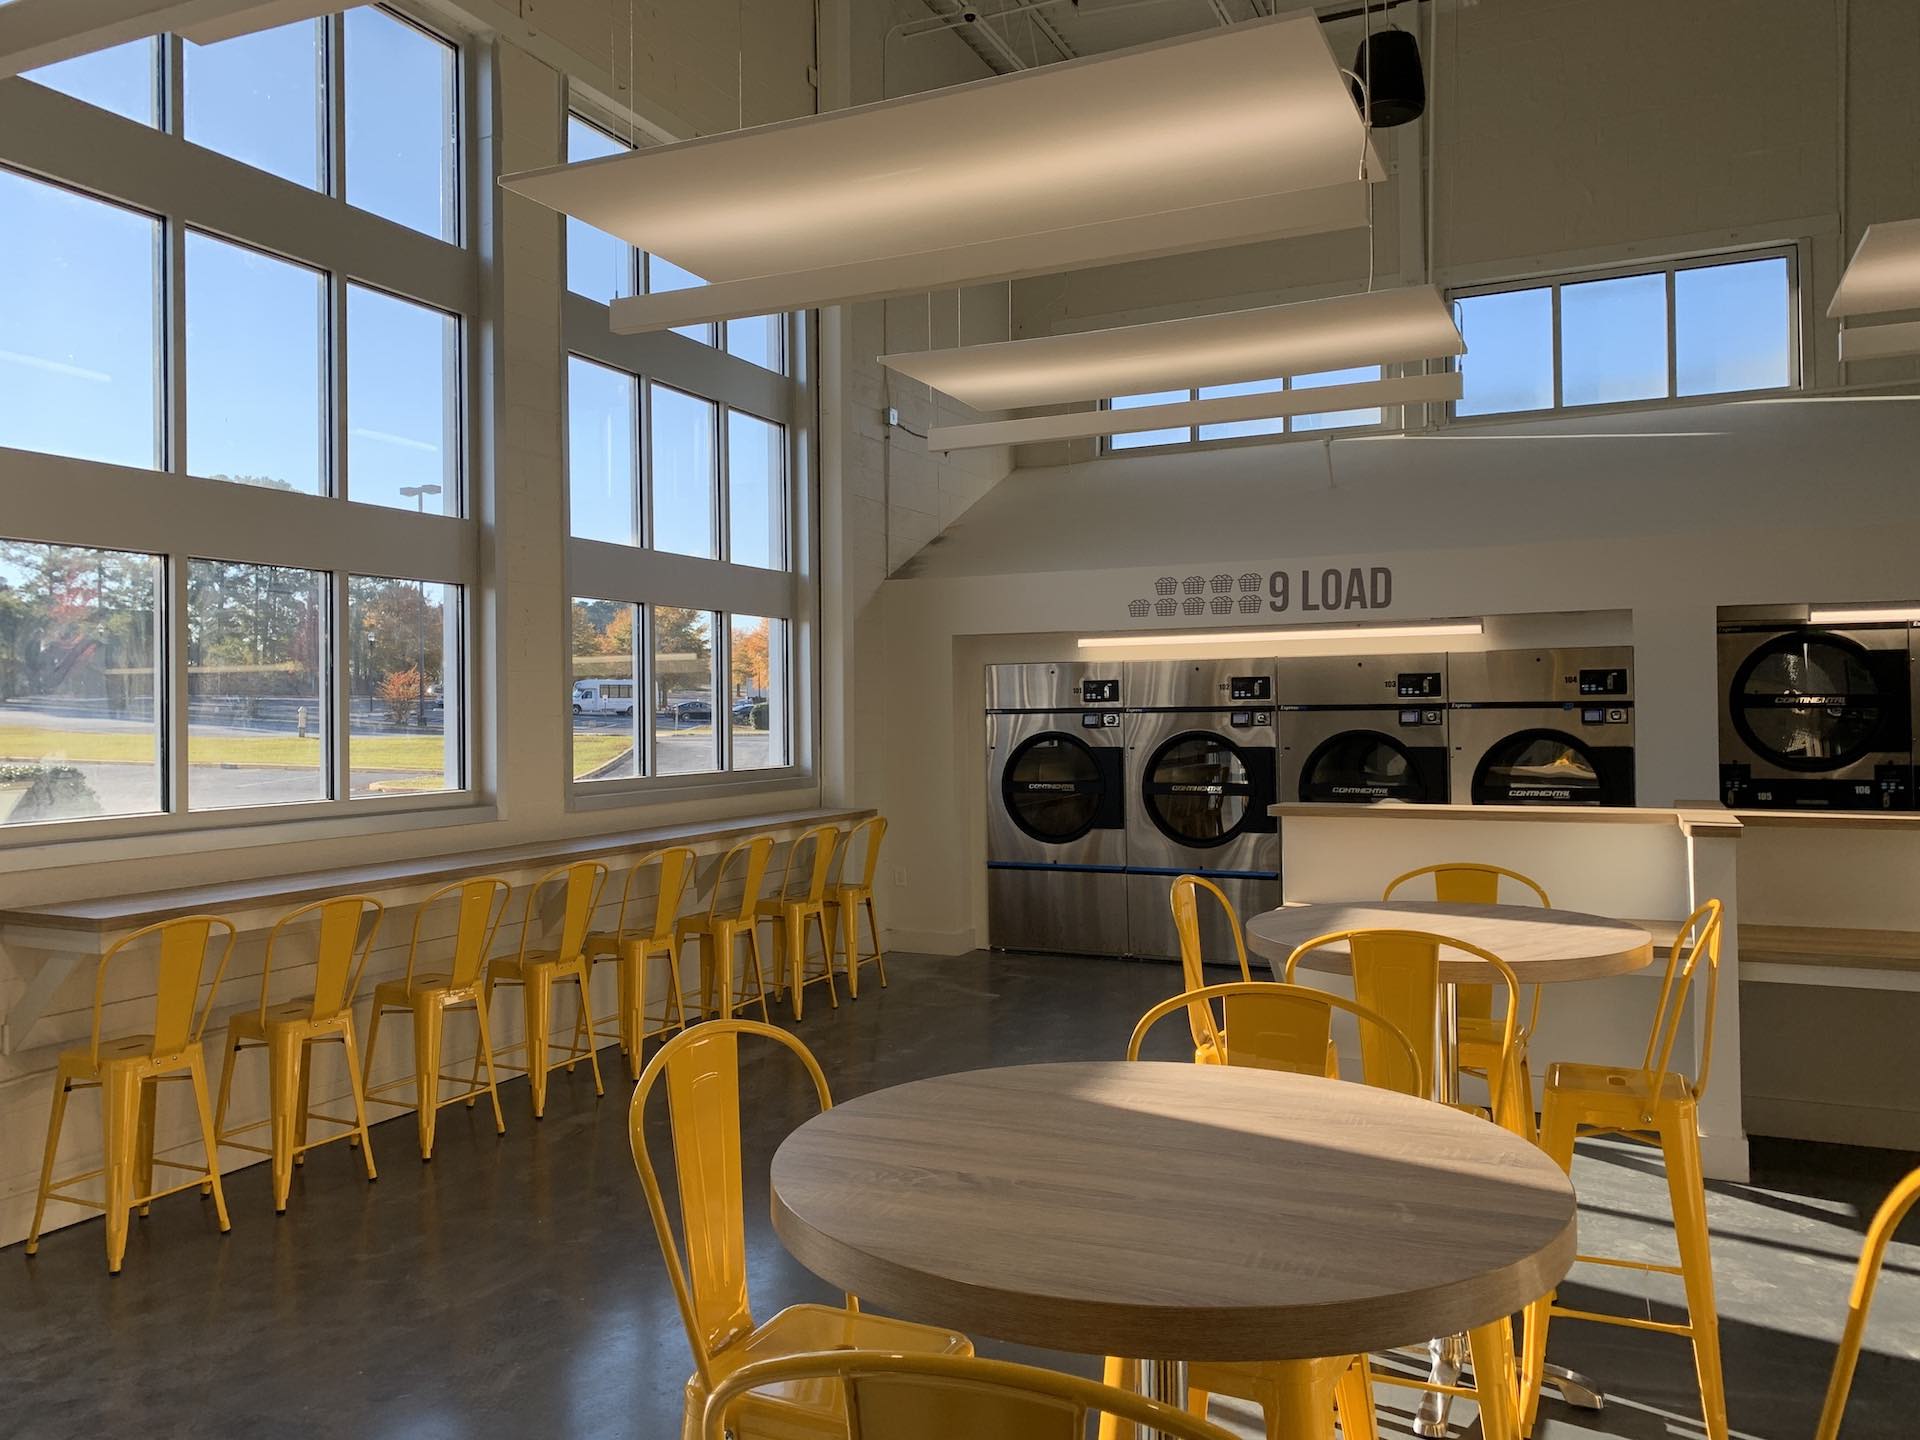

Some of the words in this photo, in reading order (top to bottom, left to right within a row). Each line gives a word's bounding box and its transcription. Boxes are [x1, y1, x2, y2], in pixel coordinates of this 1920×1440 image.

[1269, 571, 1289, 612] 9
[1302, 567, 1392, 611] LOAD
[1564, 676, 1577, 684] 104
[1774, 696, 1846, 704] CONTINENTAL
[1855, 785, 1871, 794] 106
[1508, 790, 1571, 798] CONTINENTAL
[1757, 792, 1773, 801] 105
